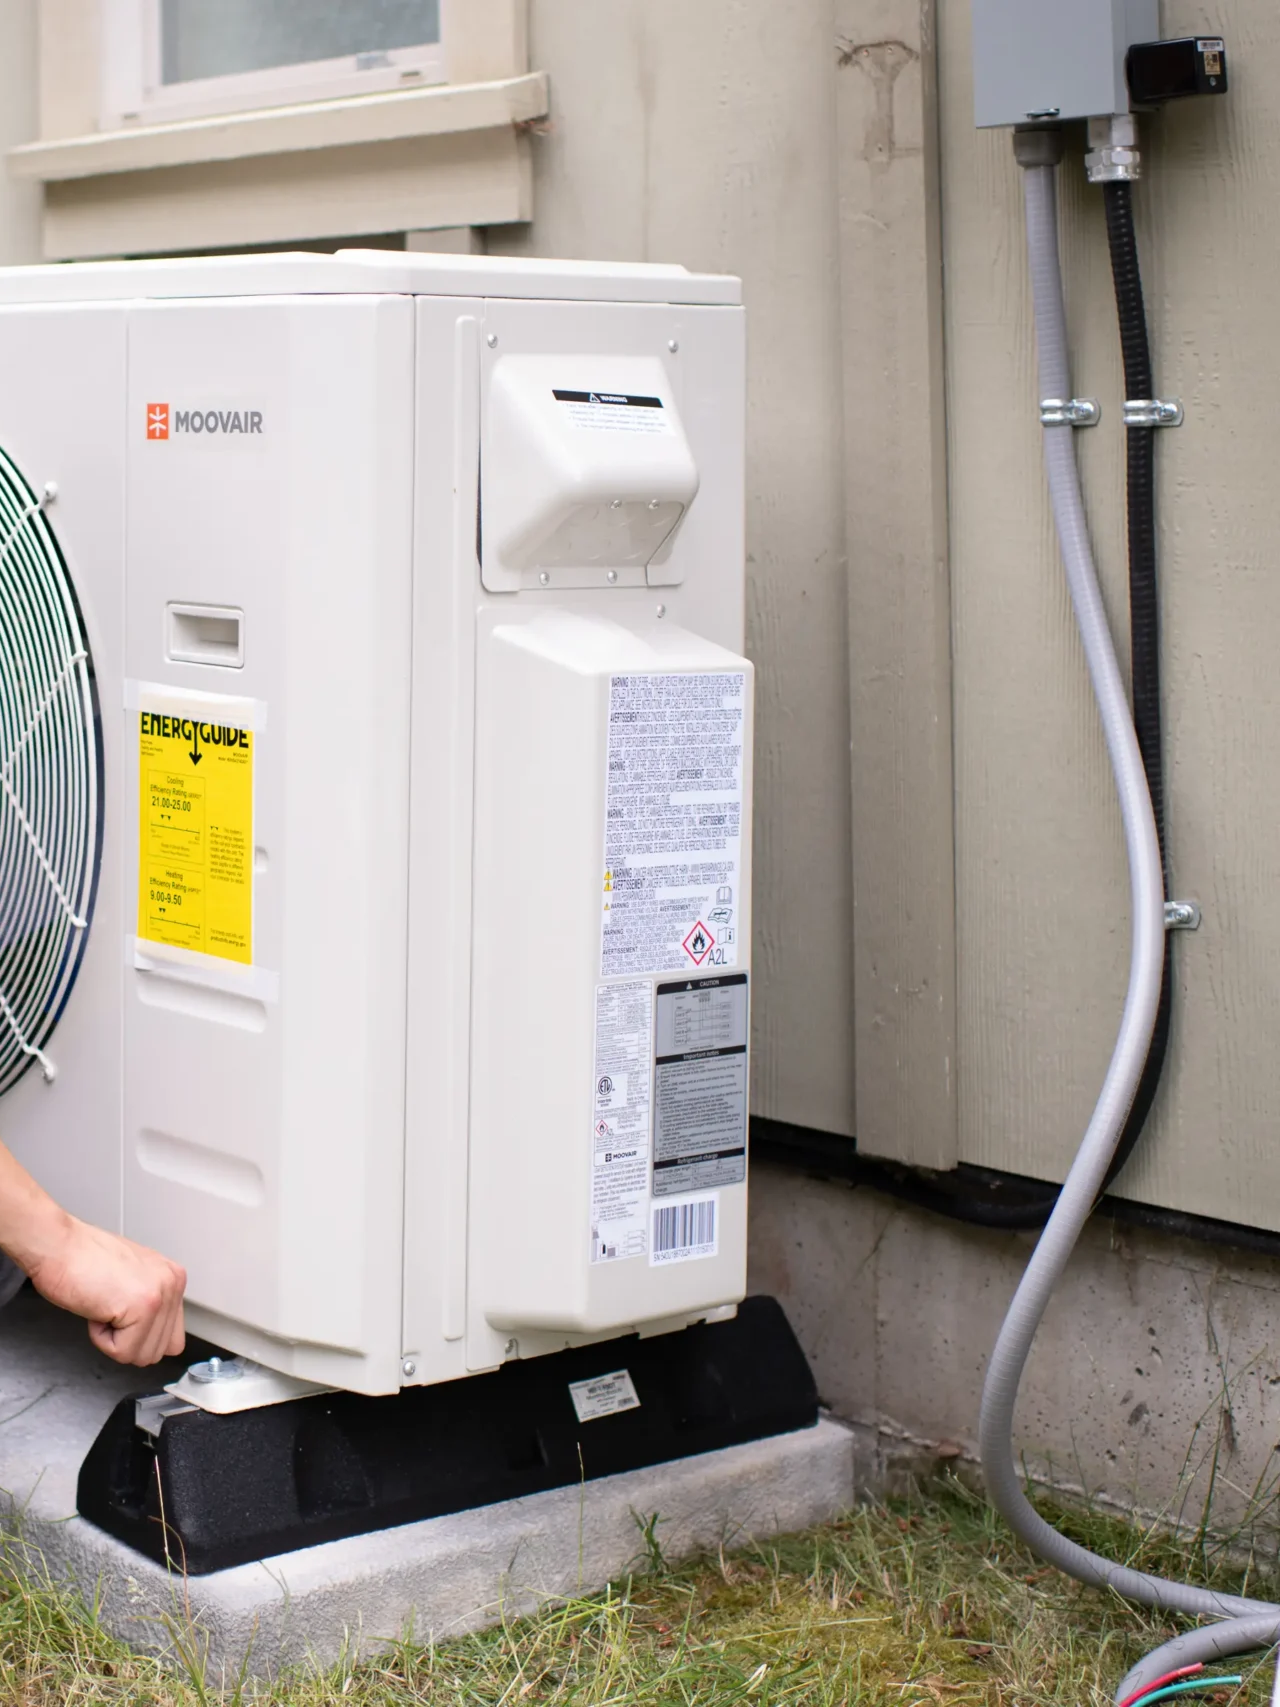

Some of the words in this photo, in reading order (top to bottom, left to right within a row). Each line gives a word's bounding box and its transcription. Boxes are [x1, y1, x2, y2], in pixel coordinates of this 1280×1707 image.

[600, 395, 627, 403] WARNING
[175, 411, 262, 433] MOOVAIR
[141, 711, 249, 749] ENERGYGUIDE
[167, 776, 184, 787] Cooling
[151, 784, 171, 797] Efficiency
[173, 788, 187, 798] Rating
[152, 796, 191, 812] 21.00-25.00
[166, 870, 183, 882] Heating
[150, 877, 171, 889] Efficiency
[172, 881, 187, 893] Rating
[150, 890, 182, 906] 9.00-9.50
[708, 948, 728, 966] A2L
[684, 1051, 705, 1060] Important
[613, 1151, 637, 1159] MOOVAIR
[677, 1156, 702, 1164] Refrigerant
